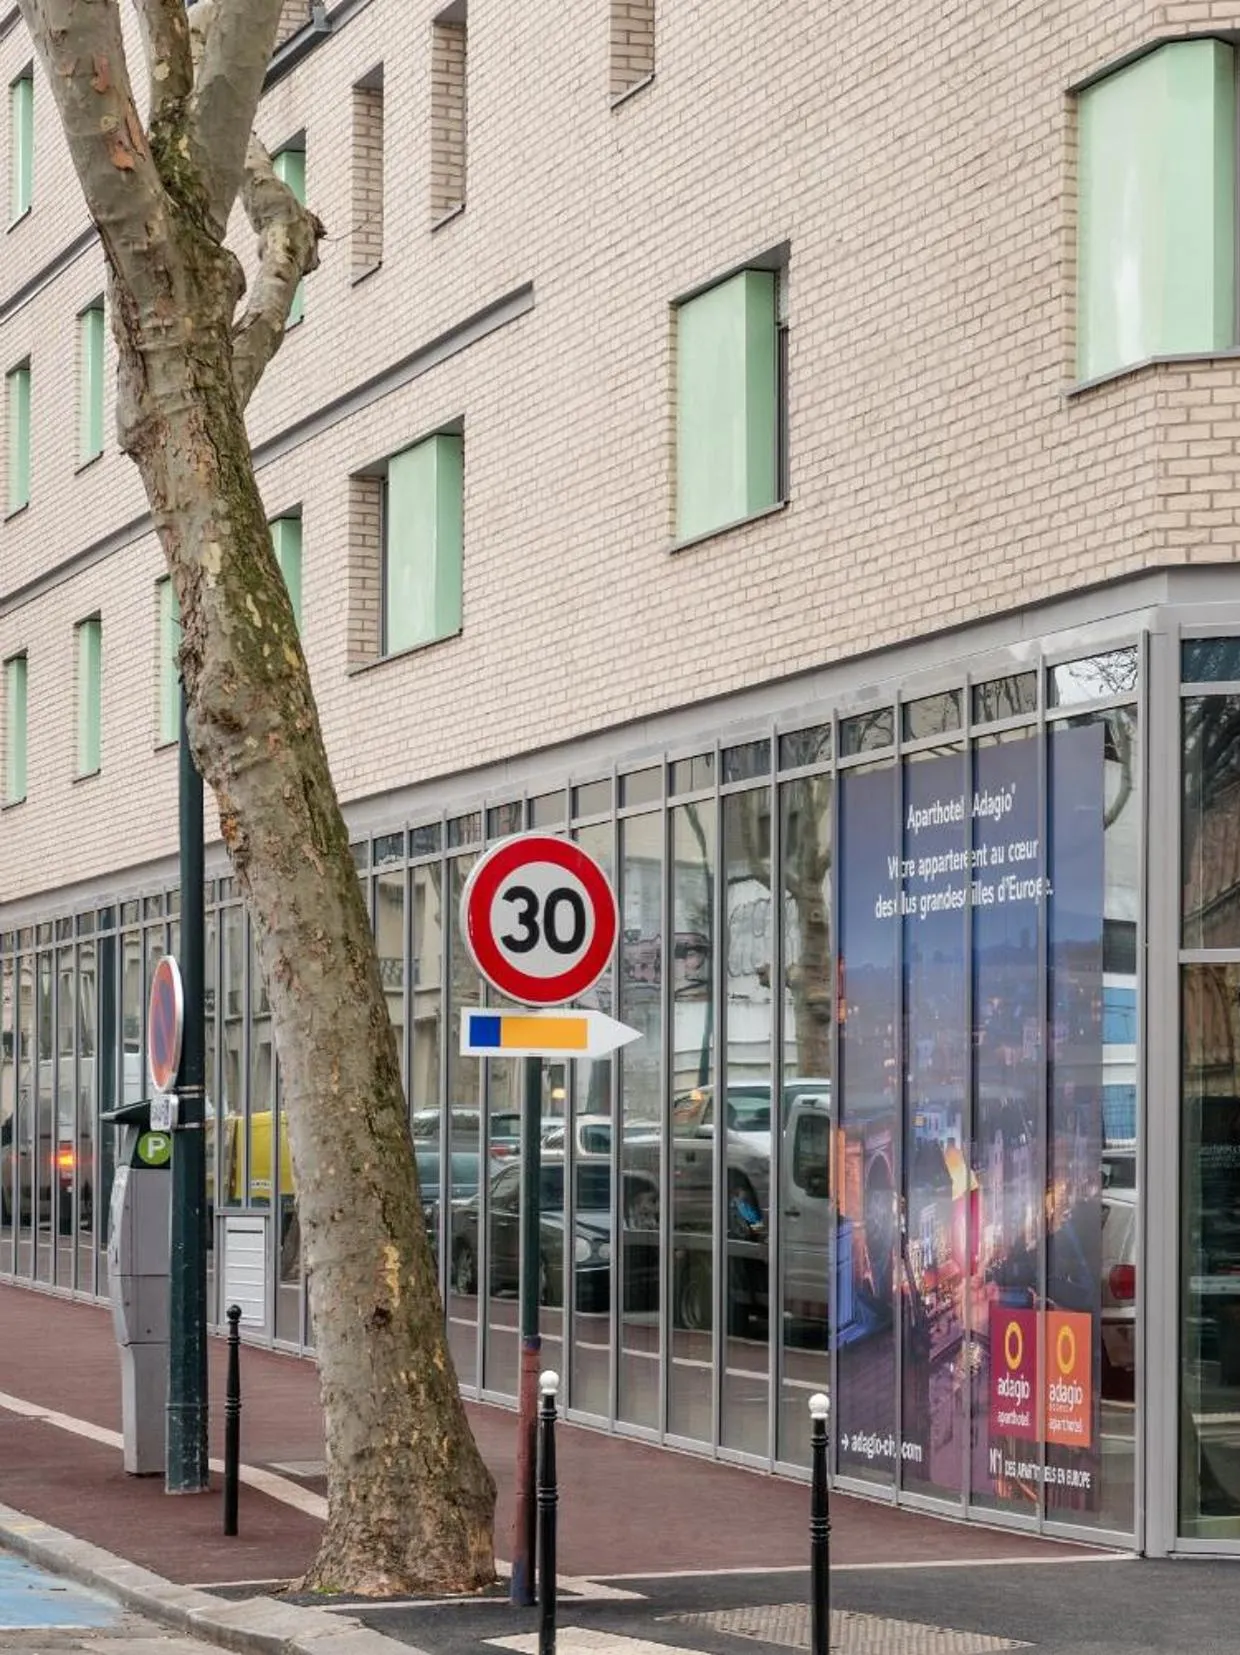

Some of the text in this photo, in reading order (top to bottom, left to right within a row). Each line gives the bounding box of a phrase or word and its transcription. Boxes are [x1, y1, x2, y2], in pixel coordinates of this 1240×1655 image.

[906, 795, 965, 836] Aparthotel
[991, 847, 1005, 865] au
[893, 890, 917, 915] lus
[920, 884, 963, 919] grandes
[500, 885, 586, 955] 30
[147, 1137, 166, 1159] P
[997, 1372, 1031, 1407] adagio
[1049, 1376, 1083, 1412] adagio
